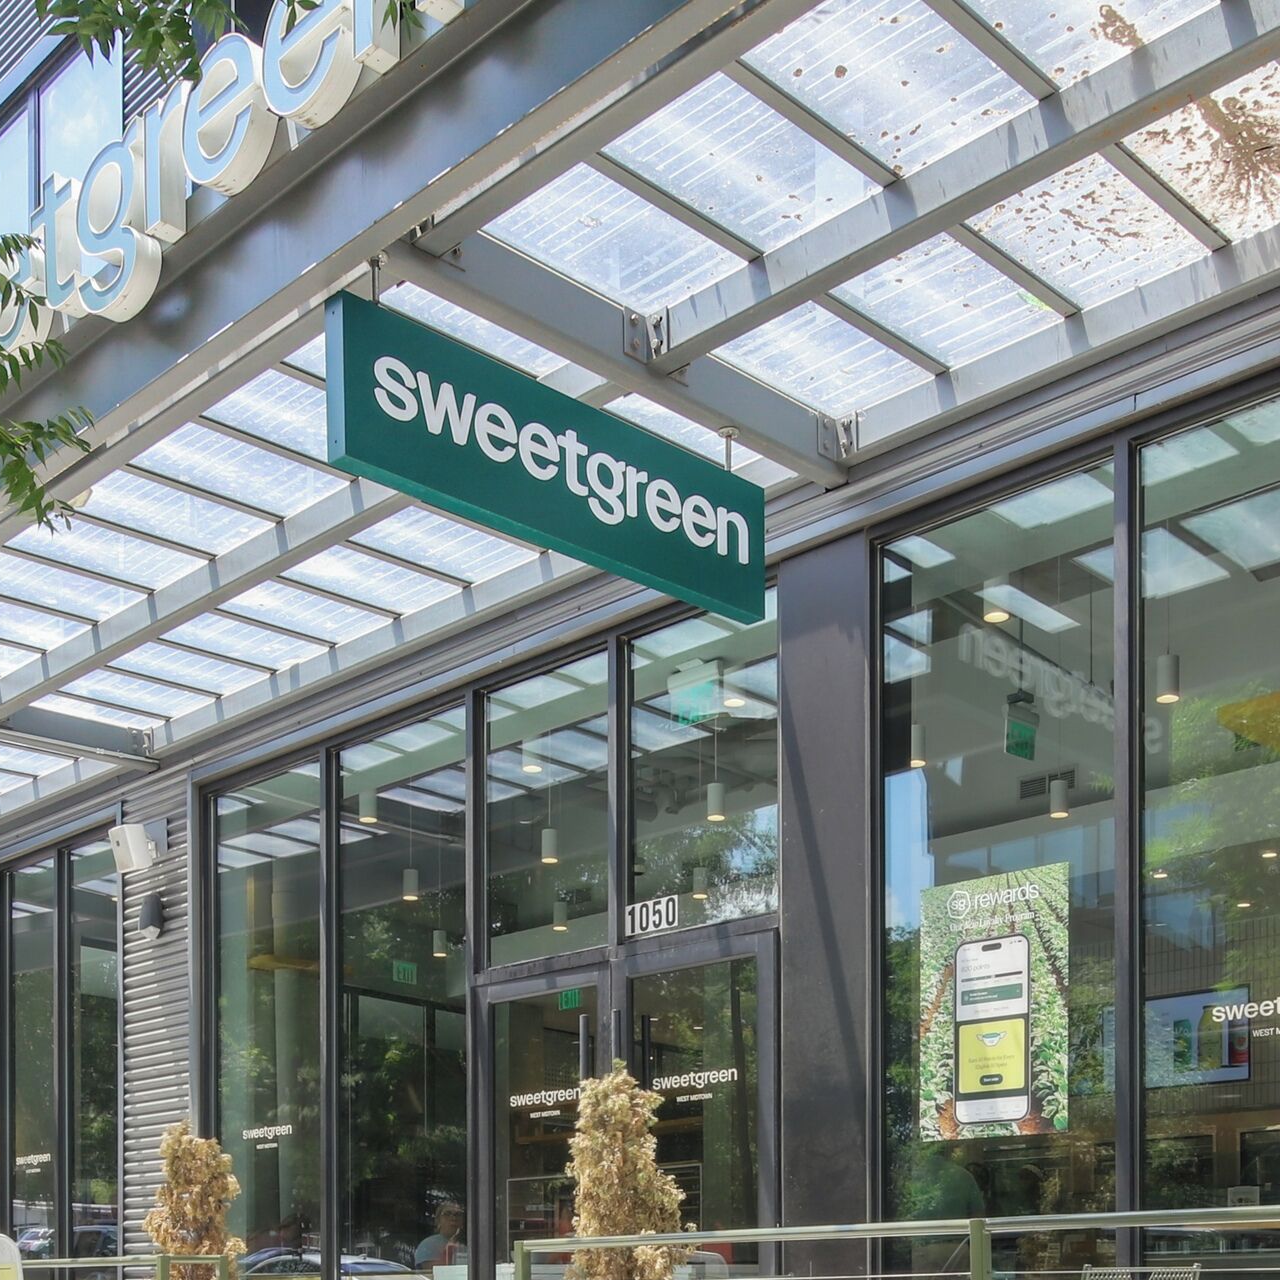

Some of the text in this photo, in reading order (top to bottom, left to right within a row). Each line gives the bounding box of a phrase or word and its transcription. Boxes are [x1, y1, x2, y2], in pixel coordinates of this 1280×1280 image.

[373, 356, 749, 565] sweetgreen
[974, 881, 1040, 909] rewards
[628, 897, 676, 934] 1050
[1252, 1027, 1275, 1038] WEST
[652, 1068, 738, 1090] sweetgreen
[510, 1087, 581, 1107] sweetgreen
[242, 1124, 293, 1140] sweetgreen
[15, 1153, 51, 1166] sweetgreen
